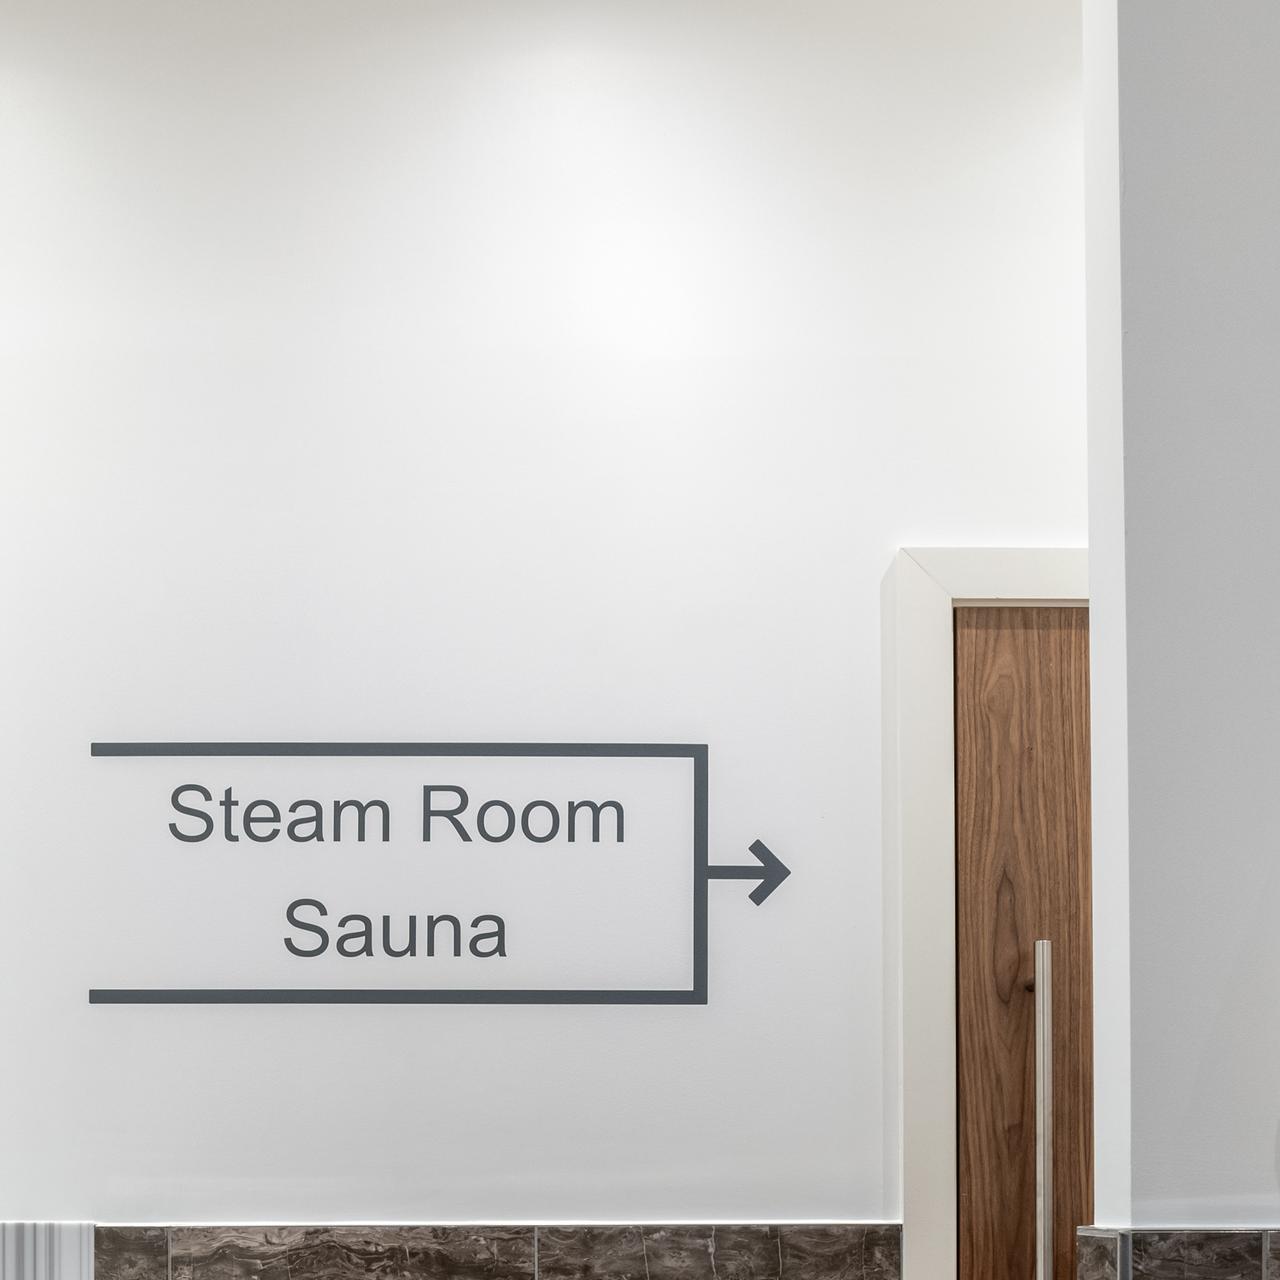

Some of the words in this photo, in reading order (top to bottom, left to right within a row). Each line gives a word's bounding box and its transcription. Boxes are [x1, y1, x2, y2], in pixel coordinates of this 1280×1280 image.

[169, 784, 389, 842] Steam
[423, 786, 623, 842] Room
[284, 899, 506, 957] Sauna
